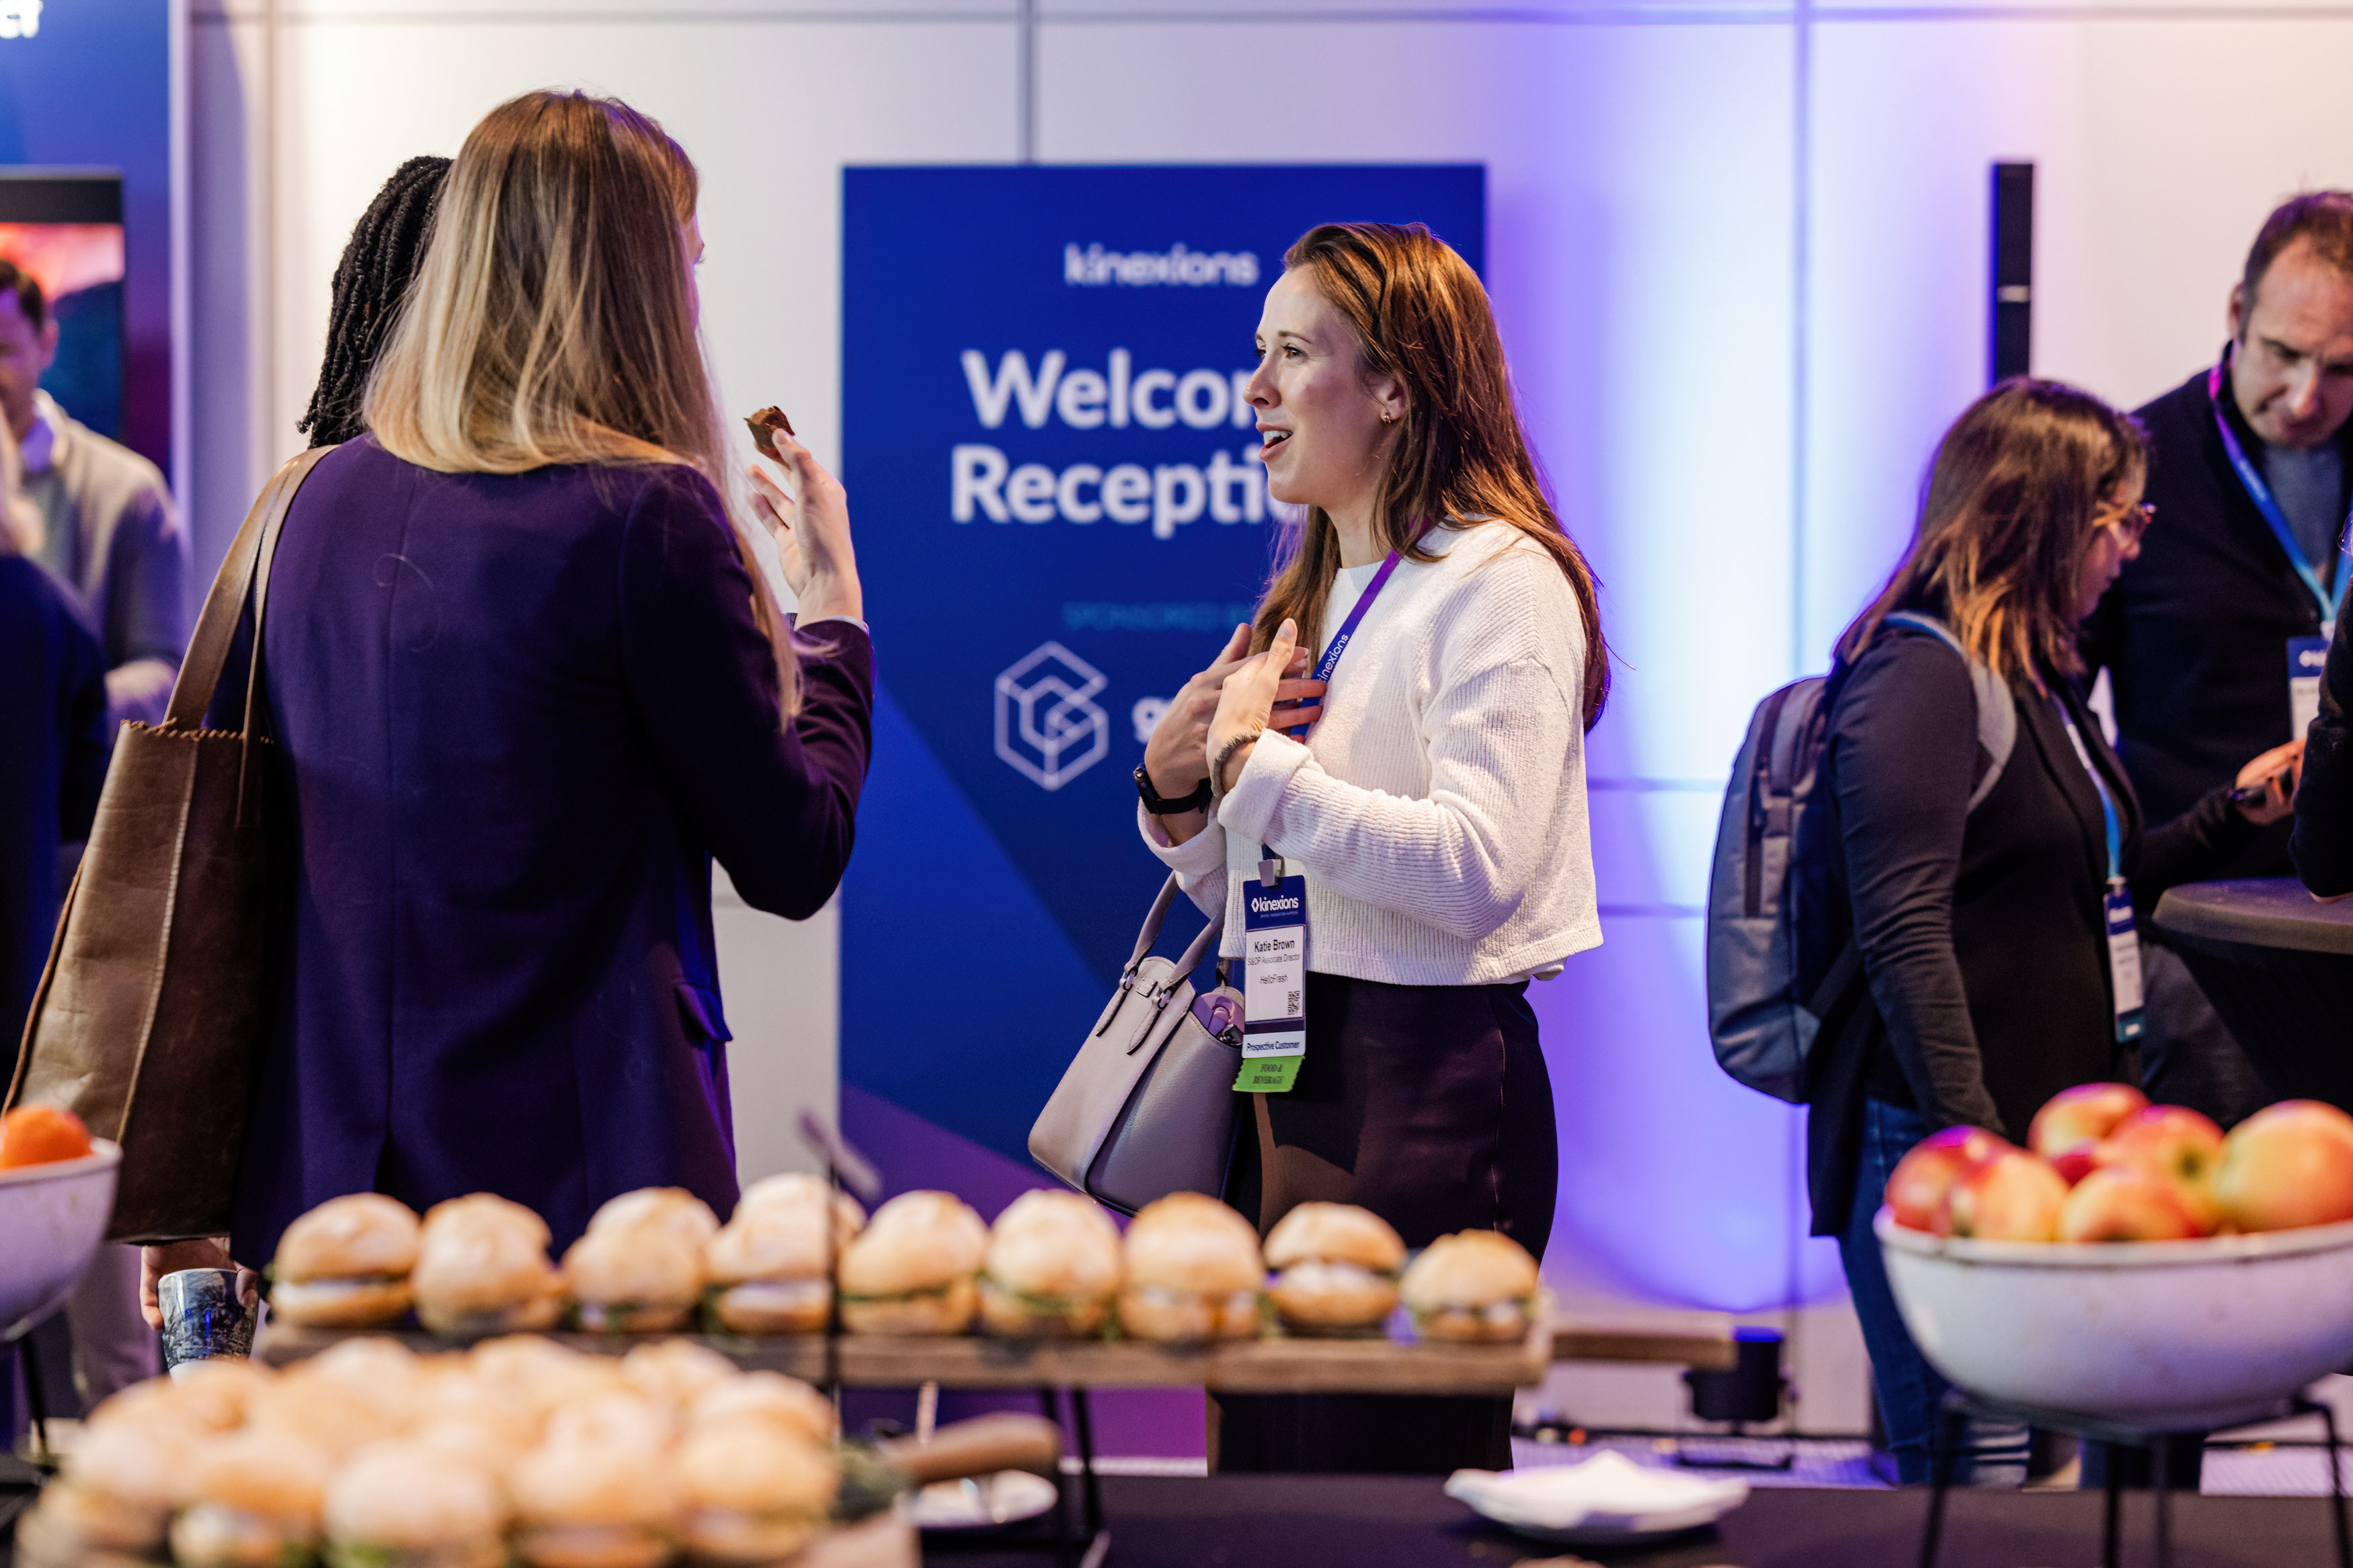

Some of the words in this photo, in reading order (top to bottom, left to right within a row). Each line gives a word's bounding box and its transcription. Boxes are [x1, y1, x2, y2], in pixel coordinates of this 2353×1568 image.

[1064, 243, 1259, 286] kinexions
[951, 443, 1307, 540] Recepti
[1317, 634, 1349, 683] inexions
[1259, 895, 1299, 912] kinexions
[1254, 941, 1271, 952] Katie
[1273, 939, 1295, 950] Brown
[1284, 954, 1300, 962] Director
[1246, 1042, 1275, 1052] Prospective
[1275, 1040, 1300, 1049] Customer
